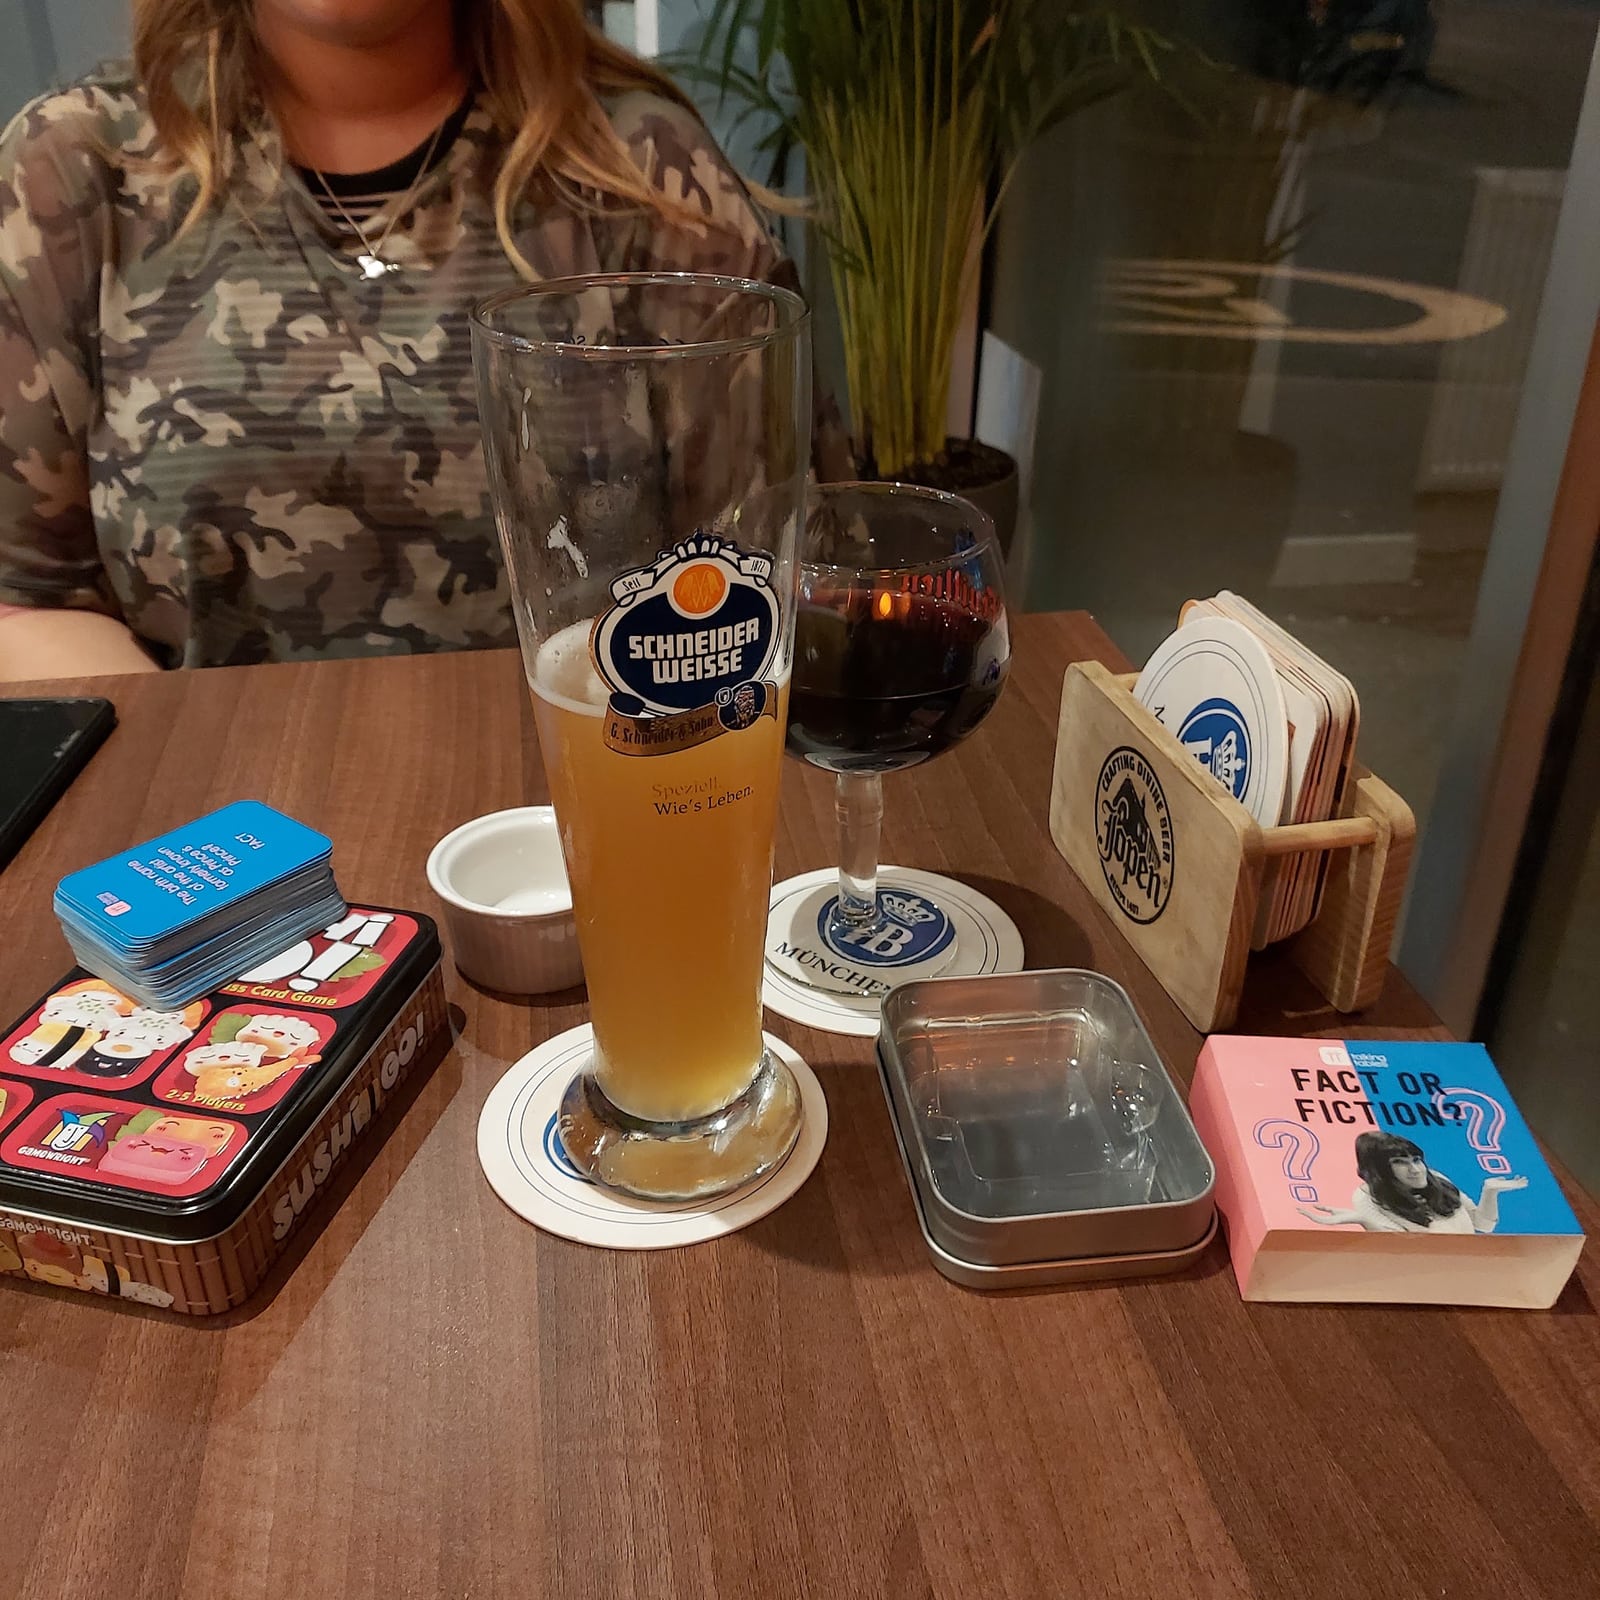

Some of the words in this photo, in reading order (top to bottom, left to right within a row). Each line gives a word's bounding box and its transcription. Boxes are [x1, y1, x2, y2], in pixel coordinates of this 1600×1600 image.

[628, 616, 761, 660] SCHNEIDER
[652, 647, 743, 684] WEISSE
[610, 721, 621, 740] G.
[653, 799, 702, 816] Wie's
[707, 784, 754, 810] Leben.
[1102, 754, 1135, 793] CRAFTING
[1137, 761, 1164, 813] DIVINE
[1159, 817, 1172, 864] BEER
[234, 832, 265, 850] FACT
[1096, 799, 1161, 908] Jopen
[127, 859, 159, 880] name
[173, 871, 193, 886] the
[154, 876, 181, 894] birth
[176, 890, 197, 906] The
[774, 941, 892, 993] MÜNCHE
[222, 983, 248, 993] ss
[250, 985, 290, 1000] Card
[291, 991, 337, 1006] Game
[379, 1010, 425, 1091] GO!
[1290, 1068, 1380, 1096] FACT
[1396, 1071, 1448, 1096] OR
[165, 1089, 193, 1101] 2-5
[192, 1093, 247, 1112] Players
[1294, 1097, 1463, 1128] FICTION?
